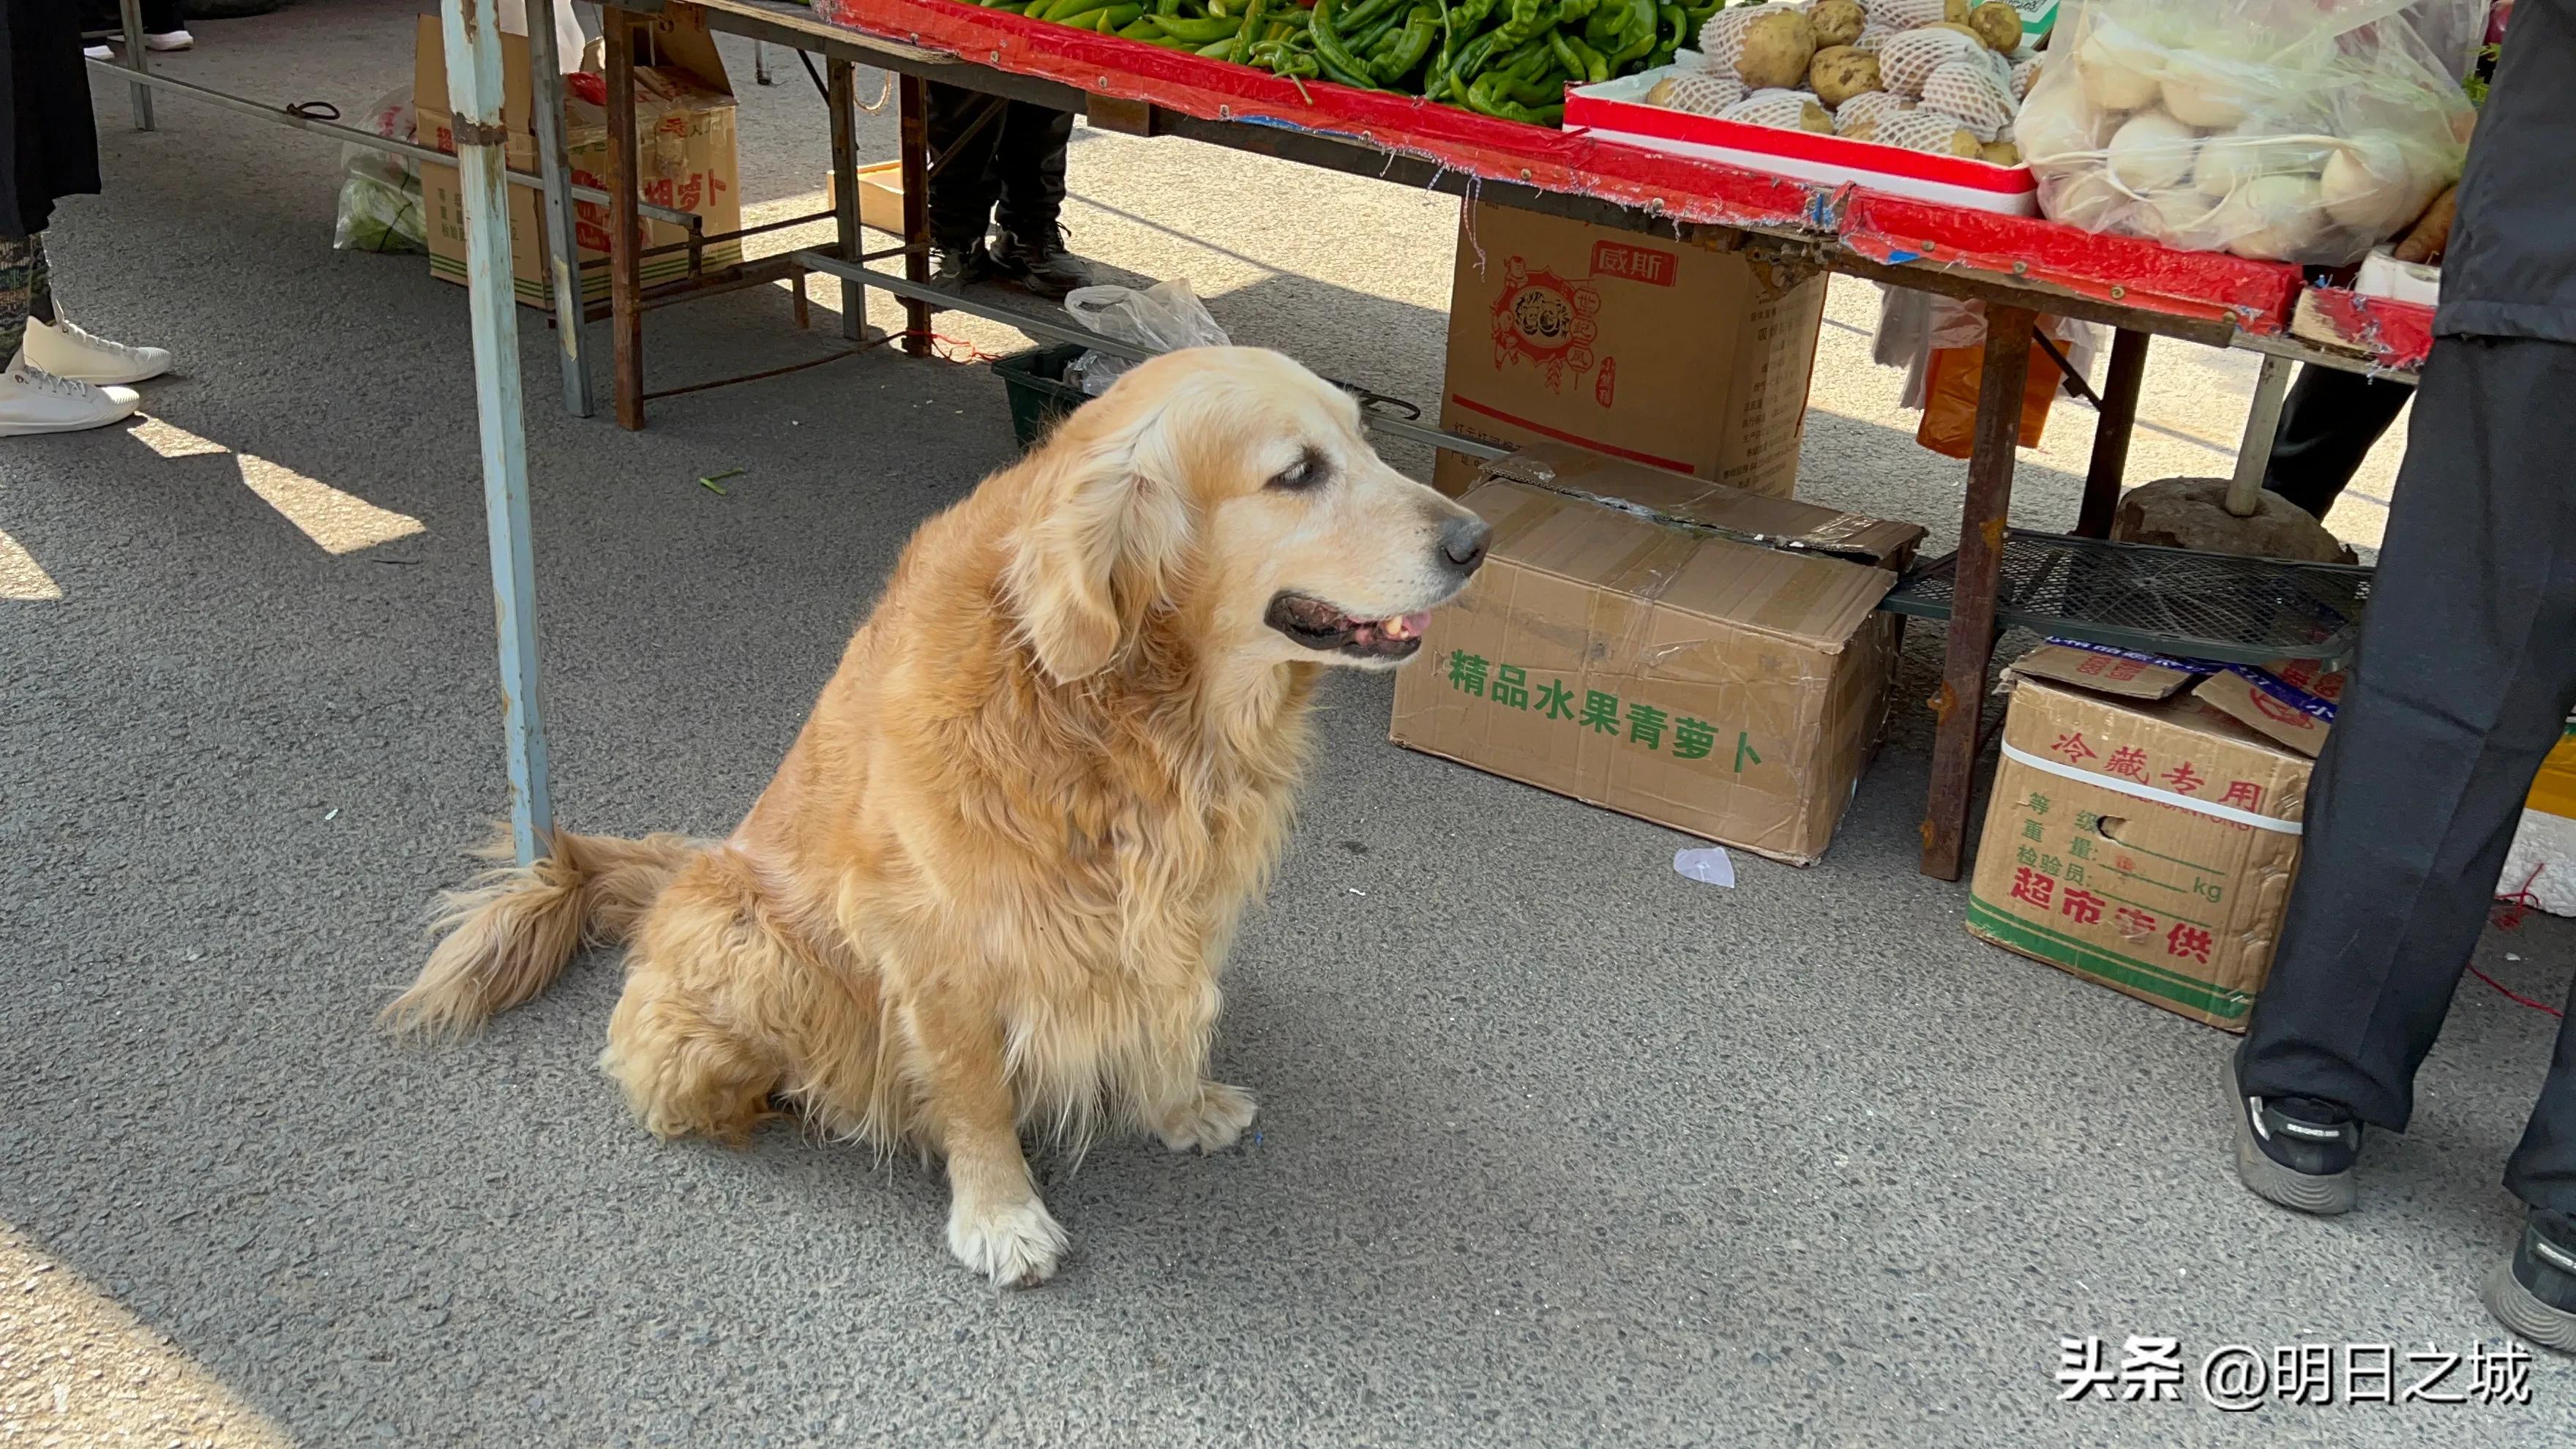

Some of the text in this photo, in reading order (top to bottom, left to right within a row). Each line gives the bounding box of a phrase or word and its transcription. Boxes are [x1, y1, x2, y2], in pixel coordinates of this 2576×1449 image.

[1598, 247, 1663, 281] 威斯
[1446, 648, 1763, 774] 精品水果青萝卜
[2049, 731, 2263, 815] 冷藏专用
[2193, 876, 2223, 904] kg
